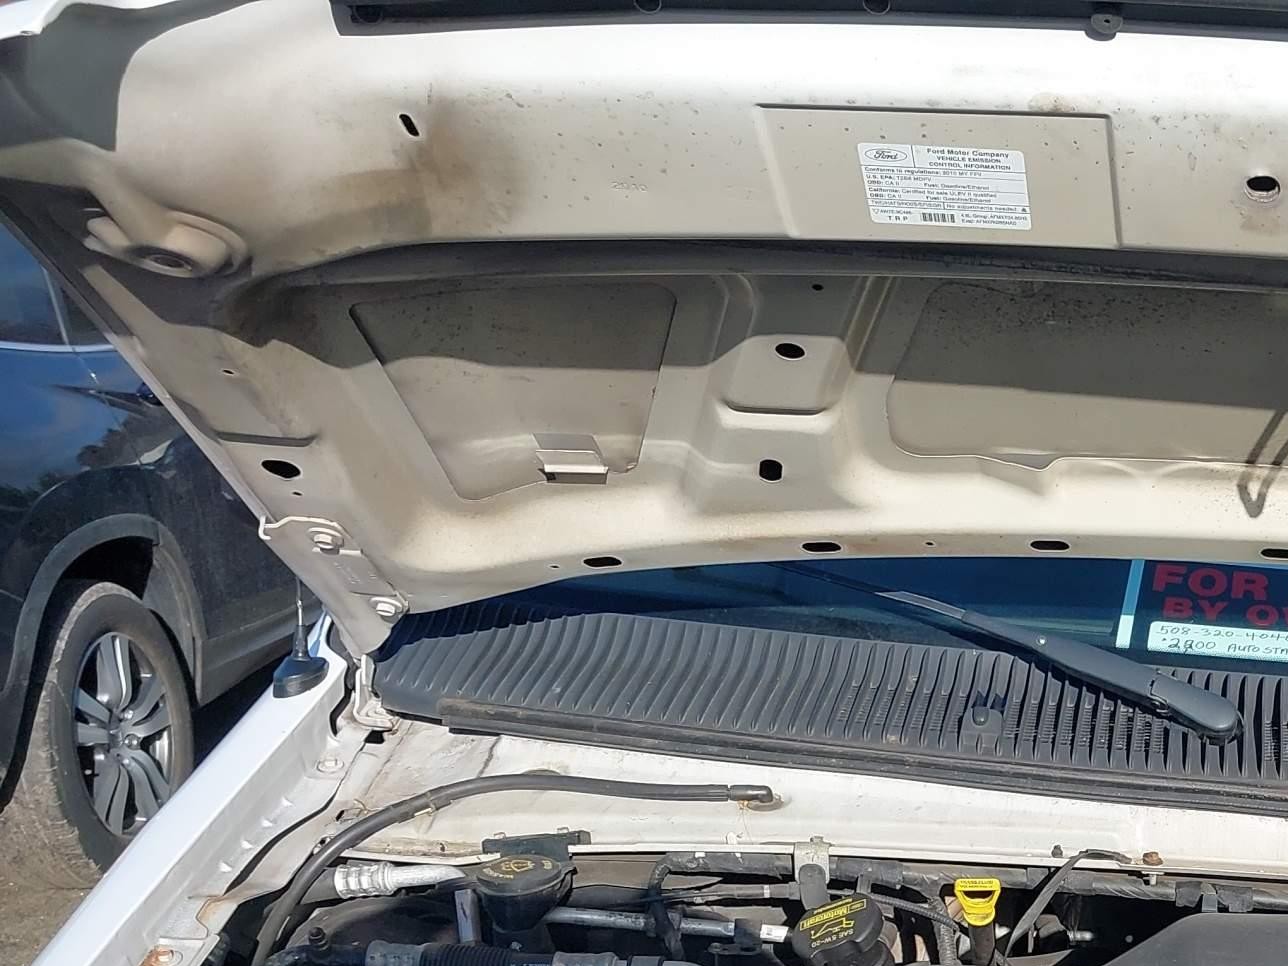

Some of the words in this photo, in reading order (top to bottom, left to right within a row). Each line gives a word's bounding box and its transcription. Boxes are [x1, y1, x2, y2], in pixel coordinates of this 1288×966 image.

[873, 150, 898, 160] Ford
[972, 150, 1009, 159] Company
[1151, 563, 1269, 600] FOR
[1162, 597, 1227, 621] BY
[803, 906, 847, 928] Motorcraft
[838, 928, 854, 939] SAE
